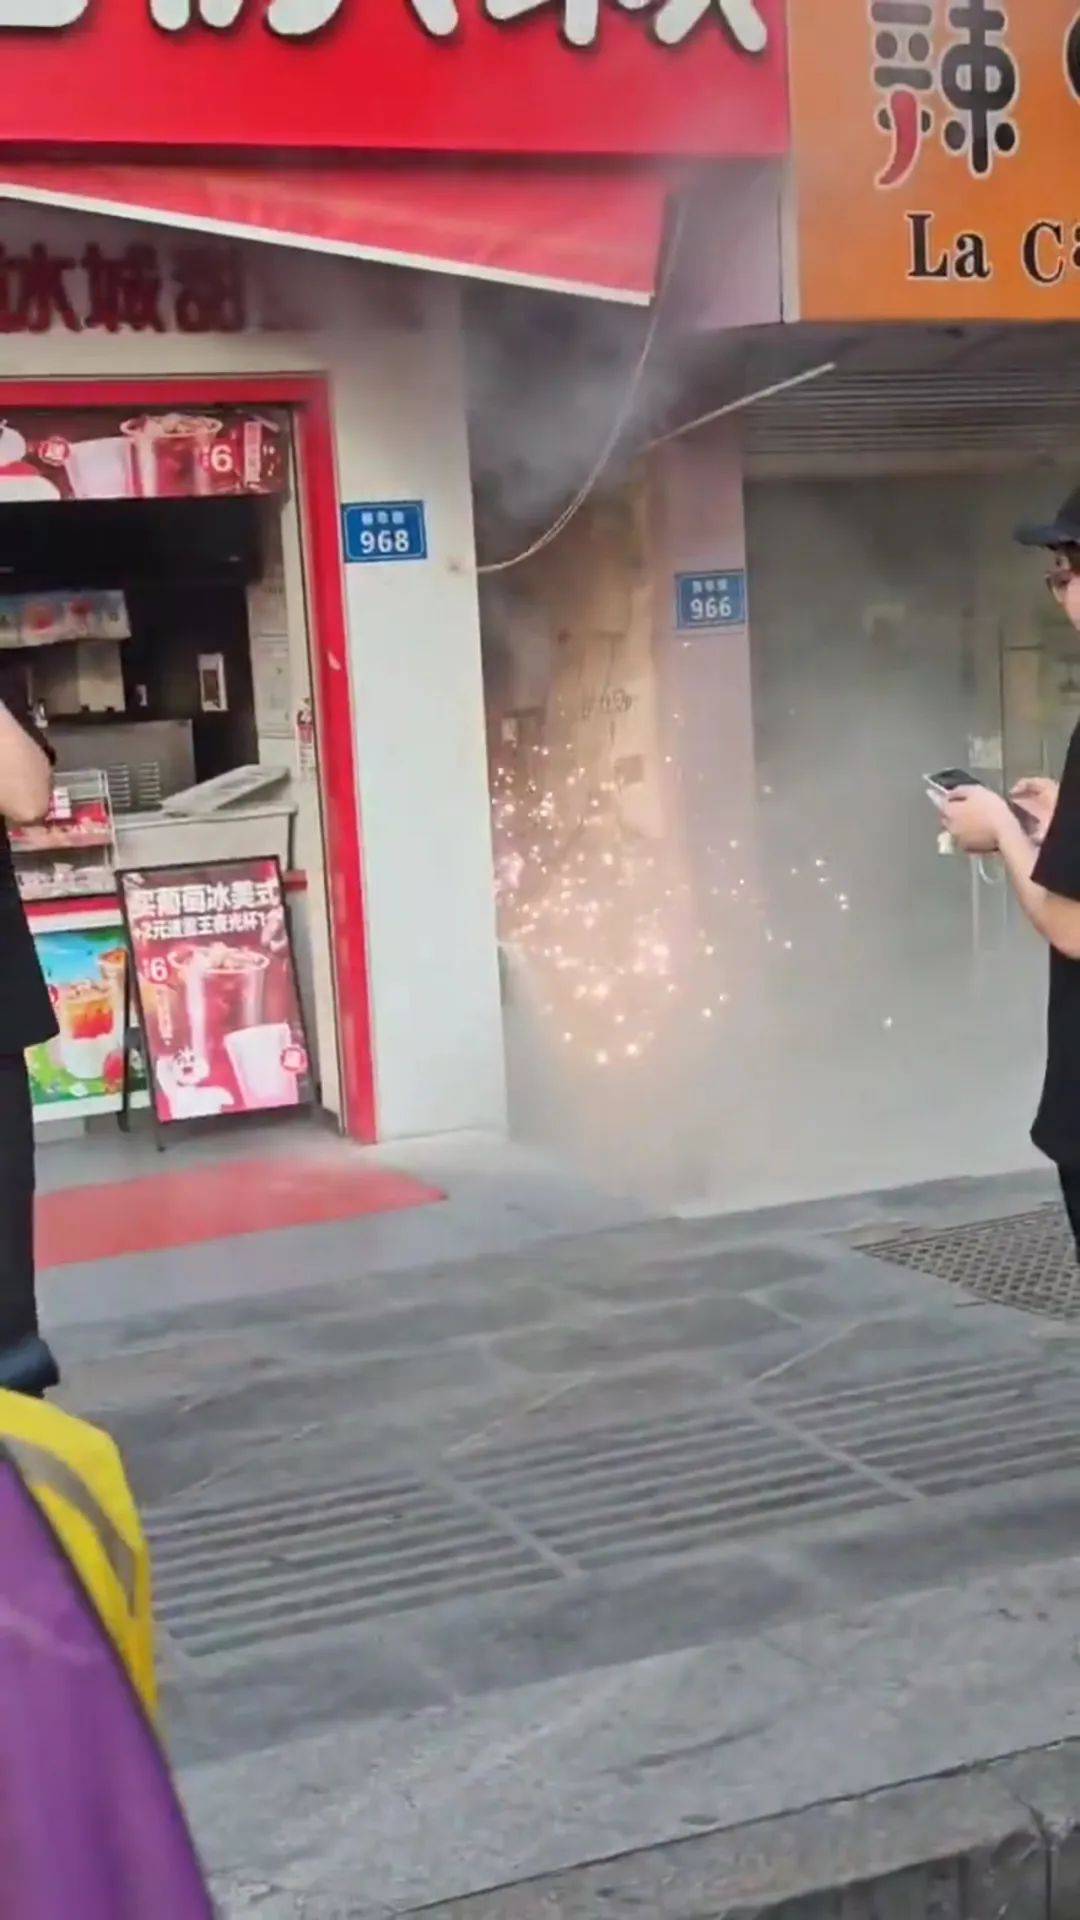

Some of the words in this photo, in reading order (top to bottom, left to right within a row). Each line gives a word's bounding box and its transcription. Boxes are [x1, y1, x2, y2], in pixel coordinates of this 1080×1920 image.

[906, 213, 990, 279] La
[210, 444, 233, 472] 6
[360, 529, 409, 554] 968
[690, 596, 732, 619] 966
[150, 955, 169, 982] 6
